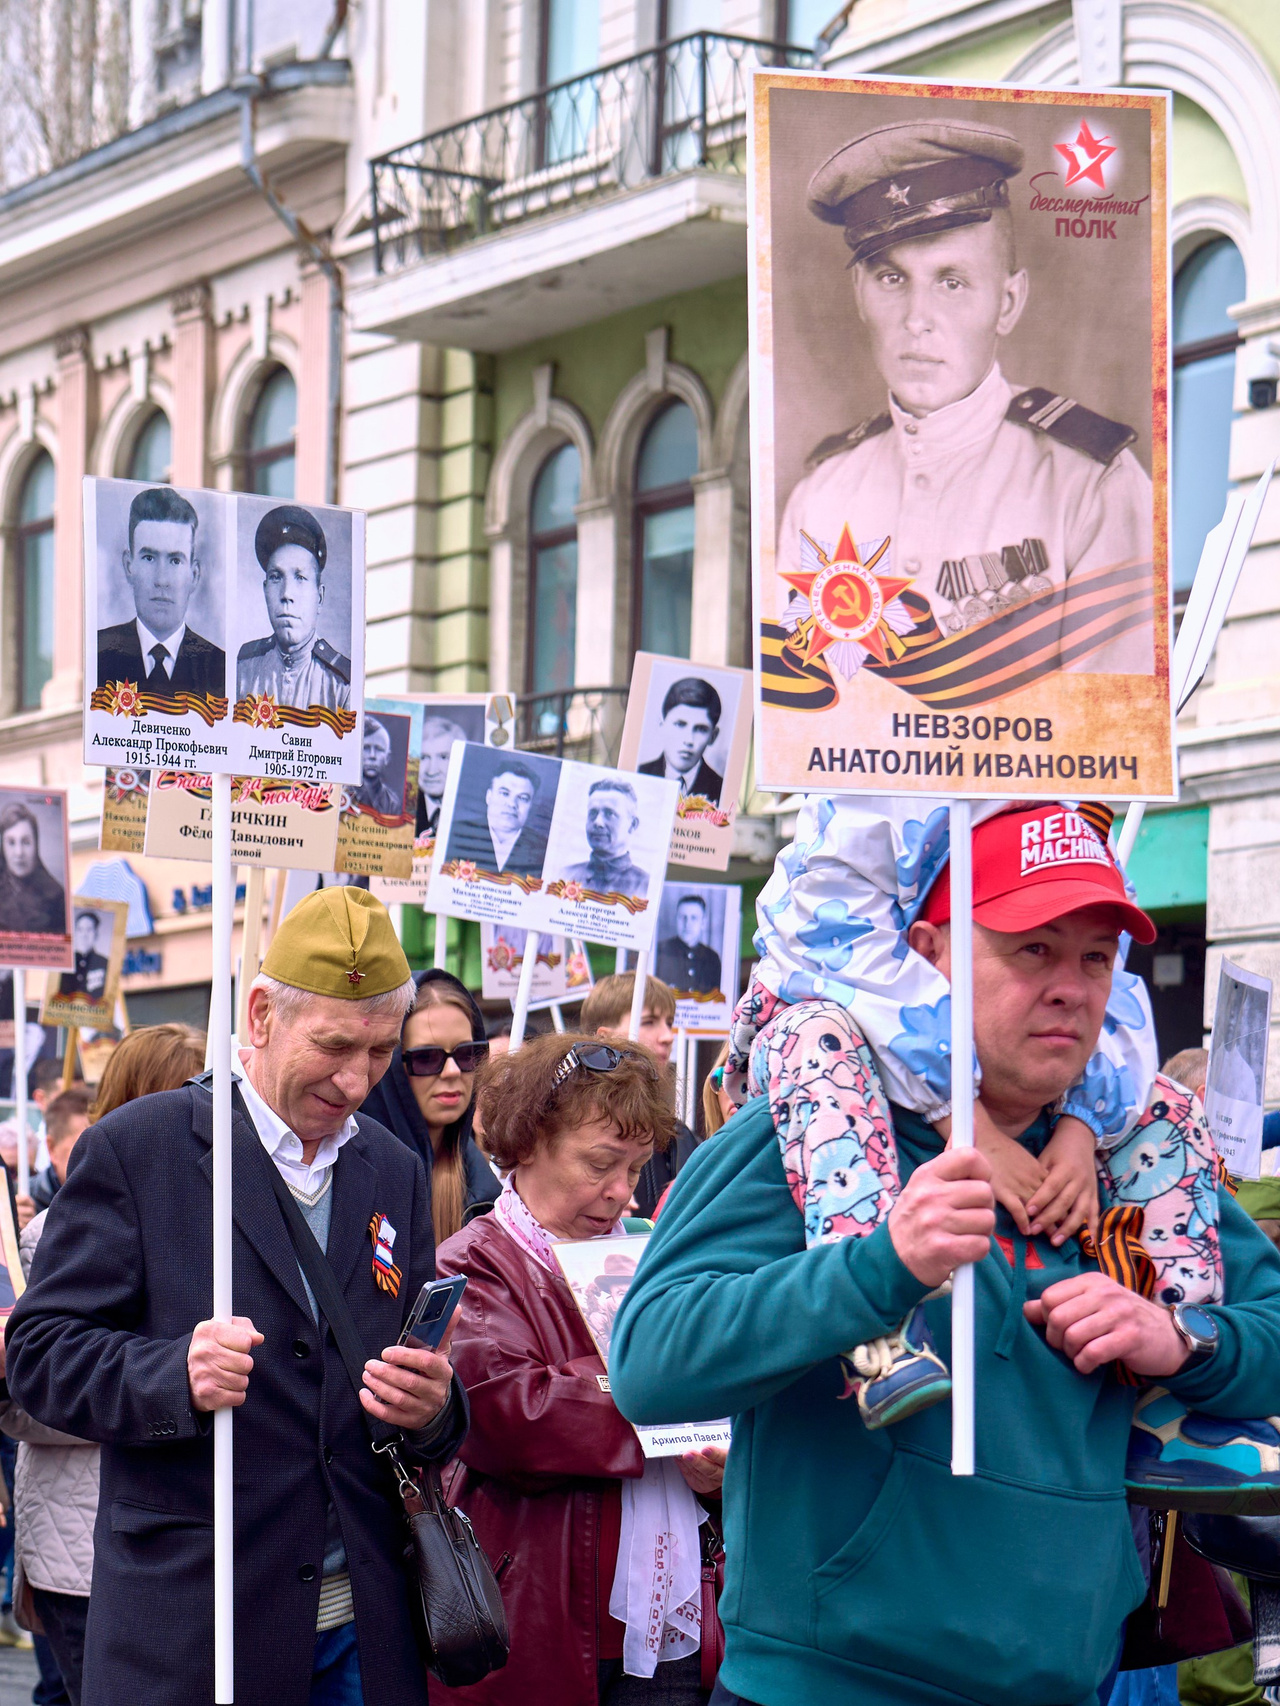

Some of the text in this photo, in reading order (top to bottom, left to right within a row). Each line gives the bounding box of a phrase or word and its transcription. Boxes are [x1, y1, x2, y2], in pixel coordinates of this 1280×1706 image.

[1029, 172, 1149, 217] бессмертный
[1055, 218, 1117, 239] ПОЛК
[132, 720, 191, 737] Девиченко
[892, 712, 1053, 741] НЕВЗОРОВ
[92, 733, 228, 755] Александр Прокофьевич
[281, 733, 312, 747] Савин
[125, 752, 181, 767] 1915-1944
[249, 745, 342, 766] Дмитрий Егорович
[807, 745, 1138, 780] АНАТОЛИЙ ИВАНОВИЧ
[264, 763, 314, 778] 1905-1972
[264, 780, 333, 809] победу!
[200, 808, 287, 828] ГИЧКИН
[1021, 812, 1083, 848] RED
[1021, 837, 1109, 871] MACHINE
[652, 1434, 693, 1446] Архипов
[693, 1433, 723, 1442] Павел
